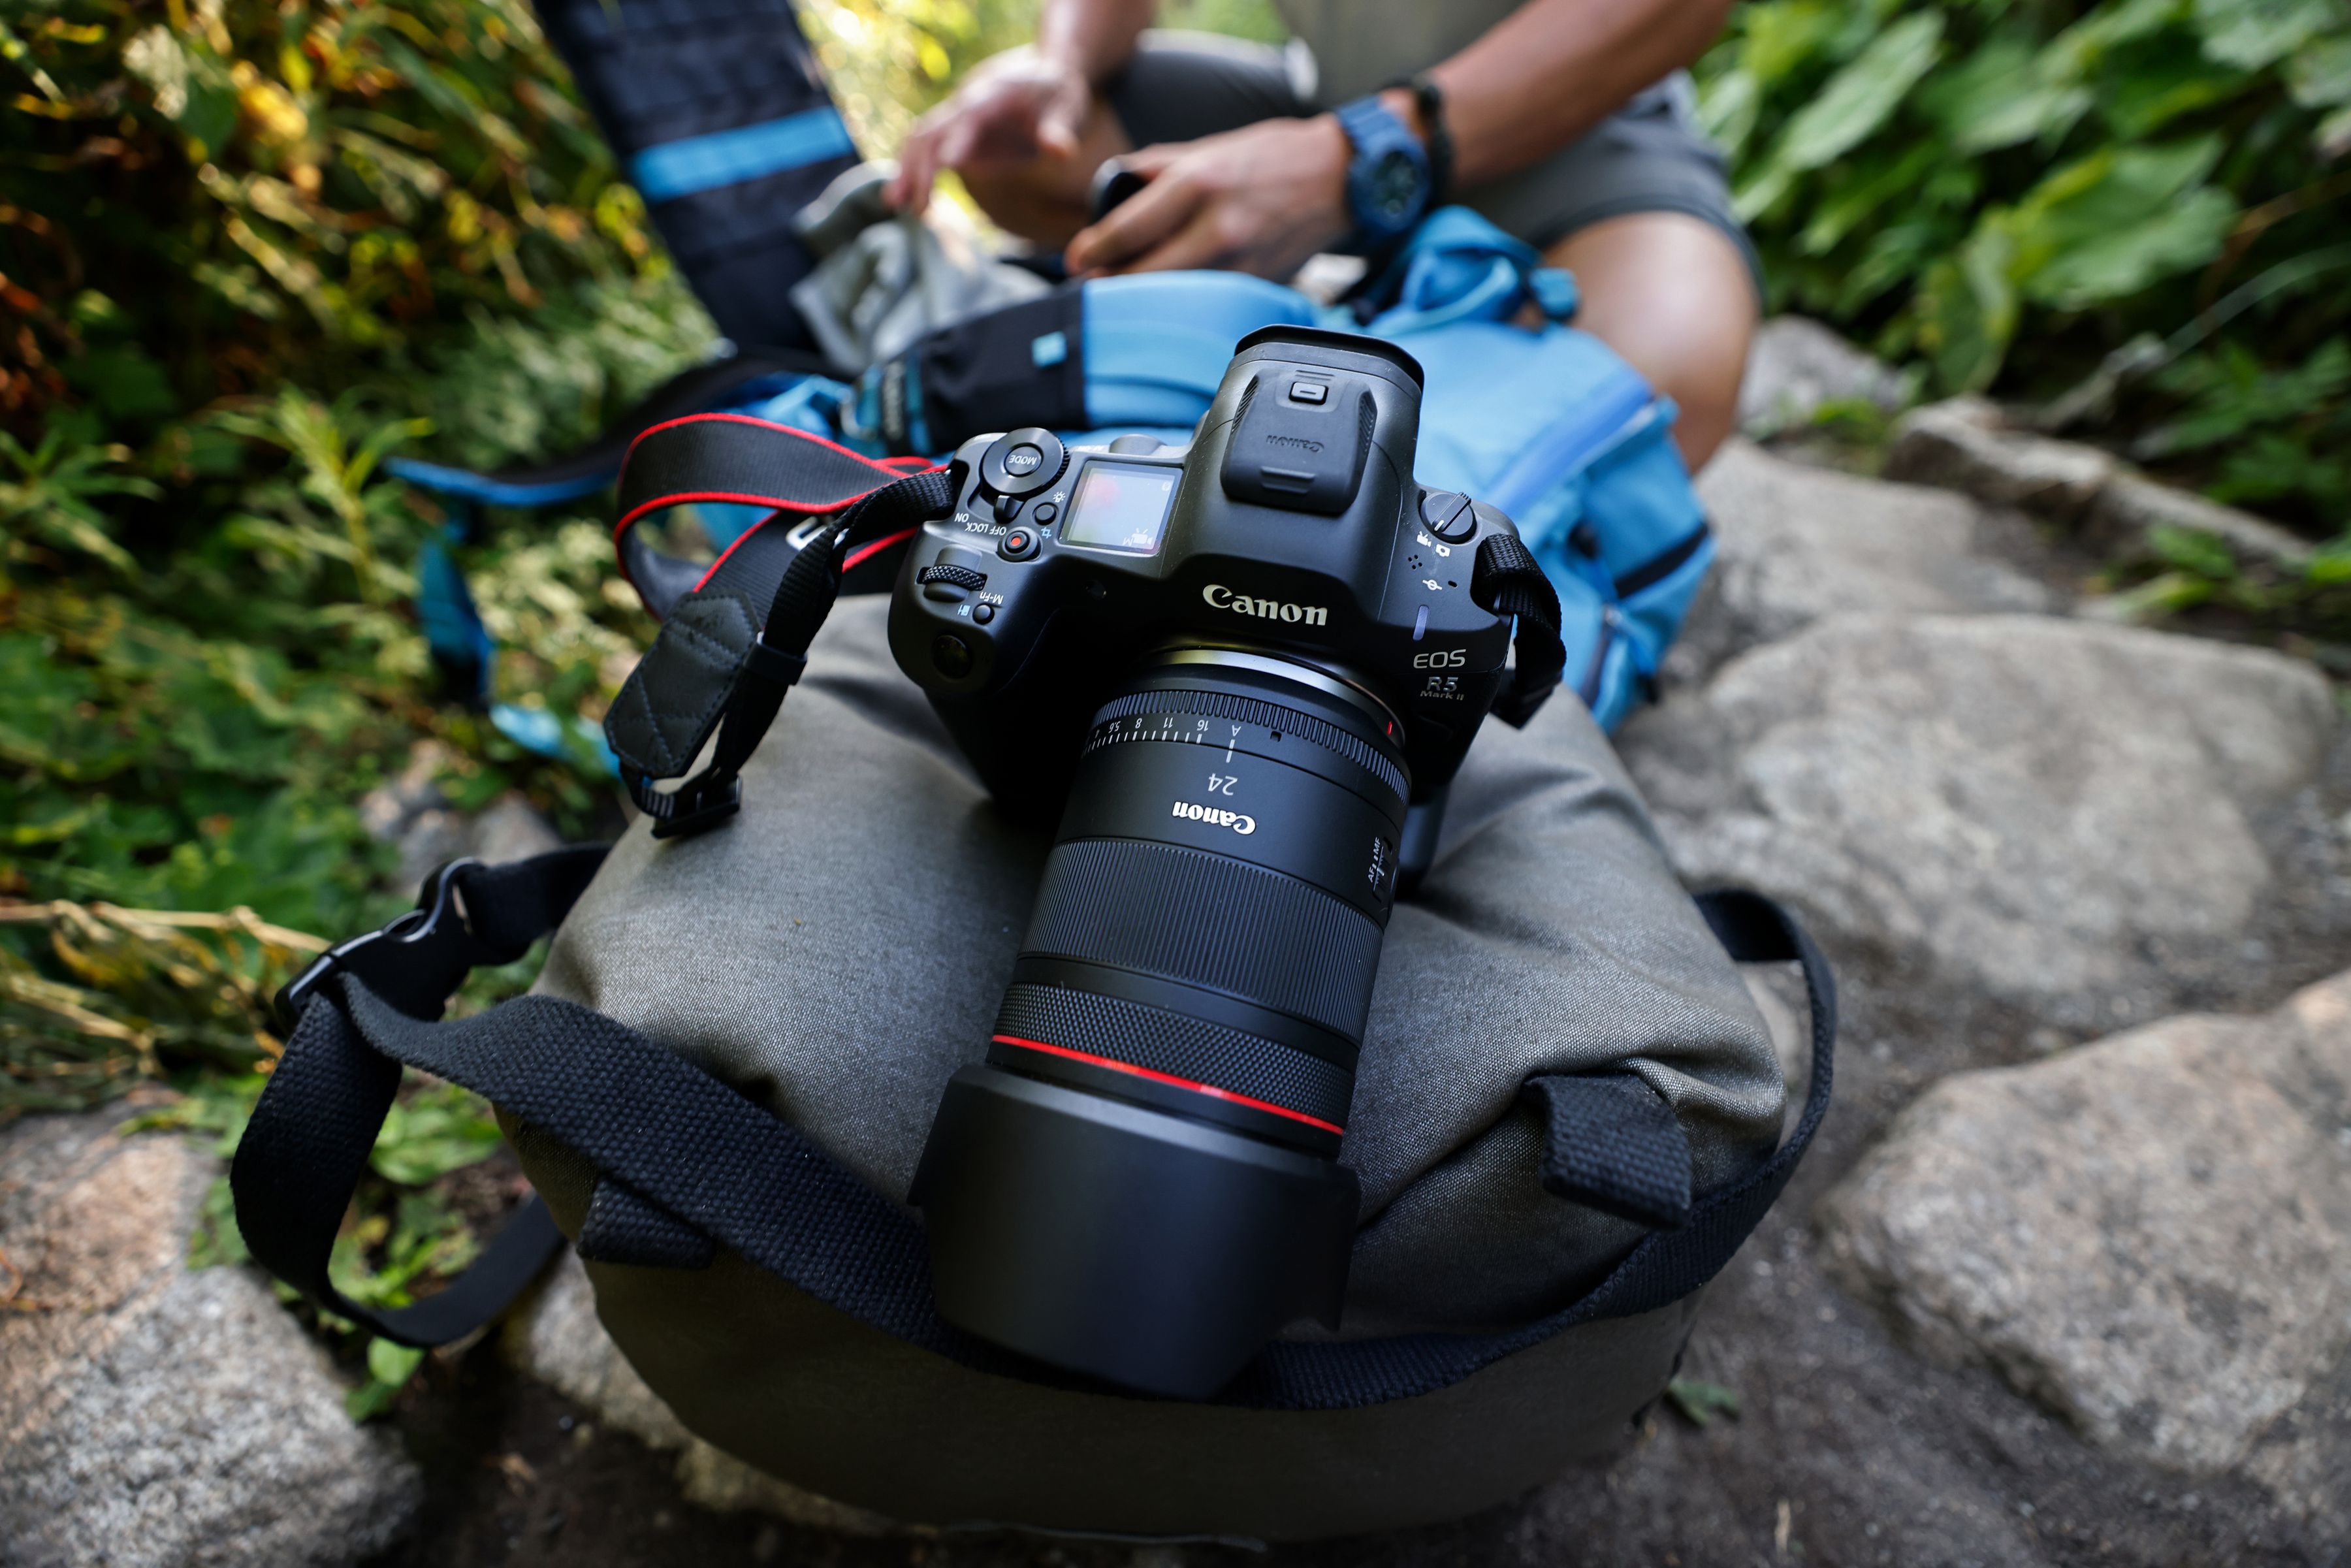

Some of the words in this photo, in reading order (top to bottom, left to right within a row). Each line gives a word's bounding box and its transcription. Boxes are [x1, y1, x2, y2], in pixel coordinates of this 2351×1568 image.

[1266, 434, 1324, 453] Canon
[1009, 455, 1037, 465] MODE
[954, 512, 969, 522] ON
[965, 522, 989, 534] LOCK
[989, 526, 1007, 536] OFF
[980, 592, 1004, 605] M-Fn
[1202, 584, 1328, 626] Canon
[1413, 648, 1467, 669] EOS
[1426, 677, 1459, 692] R5
[1420, 690, 1453, 699] Mark
[1108, 721, 1121, 733] 5.6
[1135, 718, 1143, 729] 8
[1162, 717, 1174, 729] 11
[1197, 719, 1209, 732] 16
[1232, 725, 1241, 737] A
[1208, 773, 1238, 796] 24
[1172, 801, 1256, 835] Canon
[1368, 866, 1375, 883] AF
[1373, 837, 1381, 855] MF
